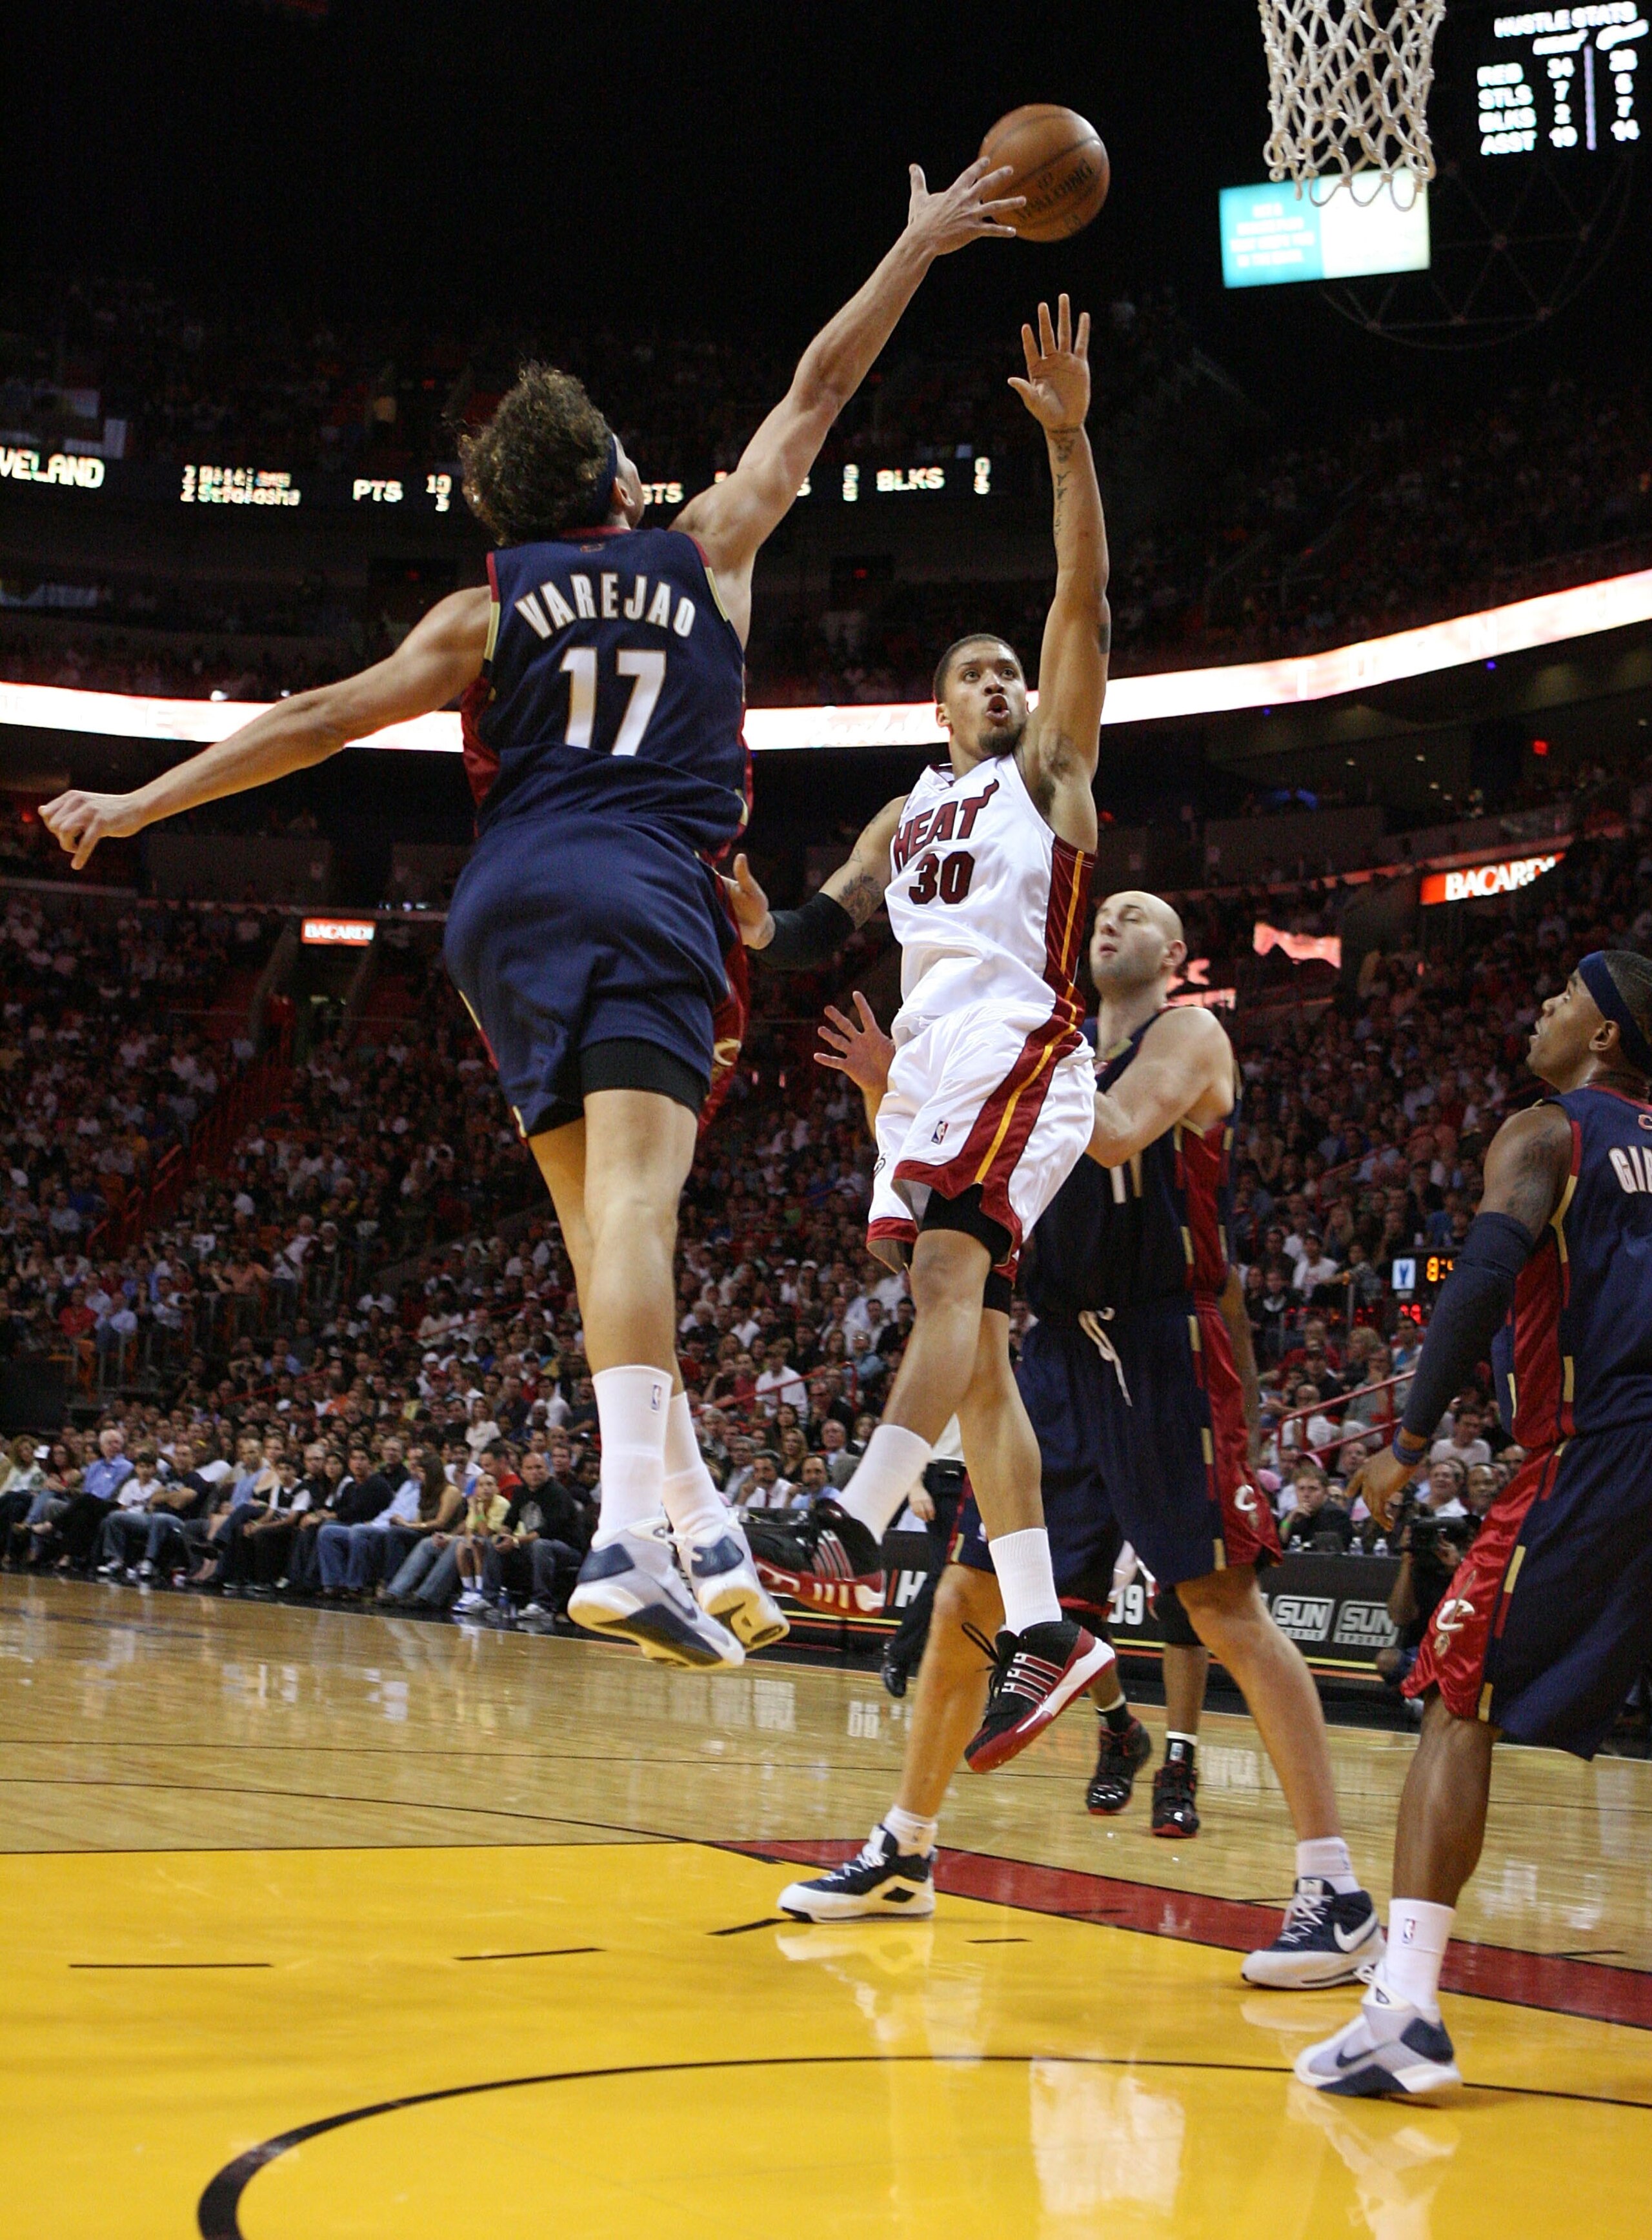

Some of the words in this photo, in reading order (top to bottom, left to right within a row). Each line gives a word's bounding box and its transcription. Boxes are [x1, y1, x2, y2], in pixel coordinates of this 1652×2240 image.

[1494, 10, 1571, 37] HUSTLE
[1571, 1, 1638, 28] STATS
[1478, 84, 1534, 109] STLS
[1478, 106, 1536, 133] BLKS
[1480, 130, 1538, 155] ASST
[352, 479, 403, 503] PTS
[876, 467, 945, 491] BLKS
[514, 572, 696, 640] VAREJAO
[559, 647, 667, 756] 17
[894, 778, 1000, 875] HEAT
[909, 851, 975, 905] 30
[305, 923, 375, 941] BACARDI
[1275, 1601, 1328, 1628] SUN
[1340, 1604, 1394, 1634] SUN
